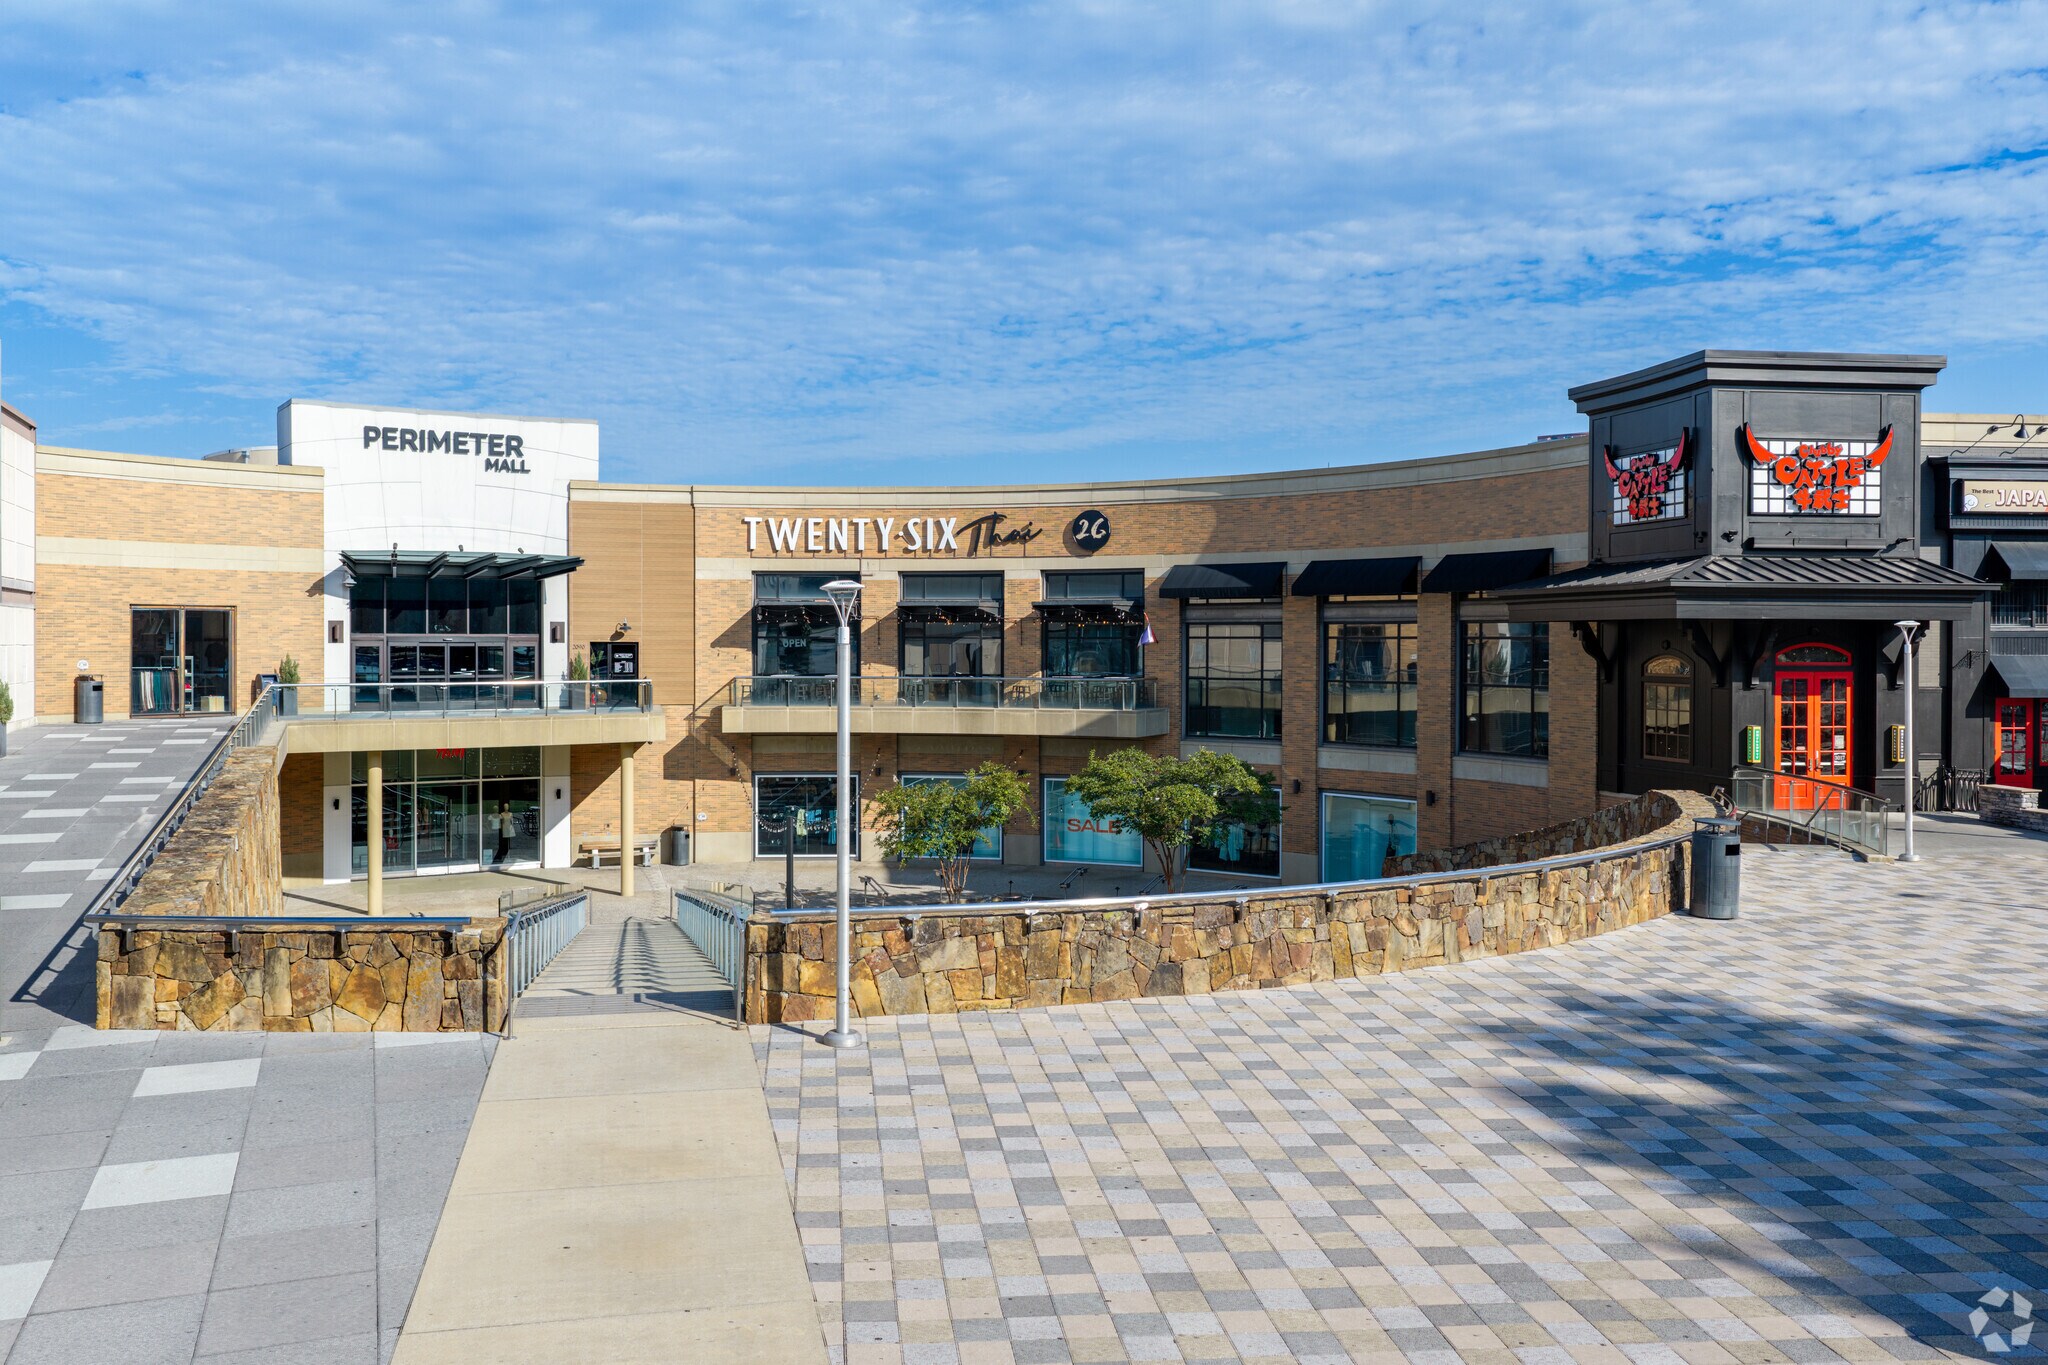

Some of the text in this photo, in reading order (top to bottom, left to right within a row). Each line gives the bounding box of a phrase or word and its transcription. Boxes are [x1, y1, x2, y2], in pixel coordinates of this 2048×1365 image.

[363, 425, 524, 458] PERIMETER
[1799, 442, 1843, 459] Chubby
[484, 458, 531, 474] MALL
[1775, 456, 1866, 489] CATTLE
[1618, 465, 1669, 499] CATTLE
[1995, 489, 2048, 507] JAPA
[956, 511, 1043, 552] Thai
[1075, 517, 1107, 540] 26
[782, 638, 807, 648] OPEN
[1067, 818, 1122, 834] SALE
